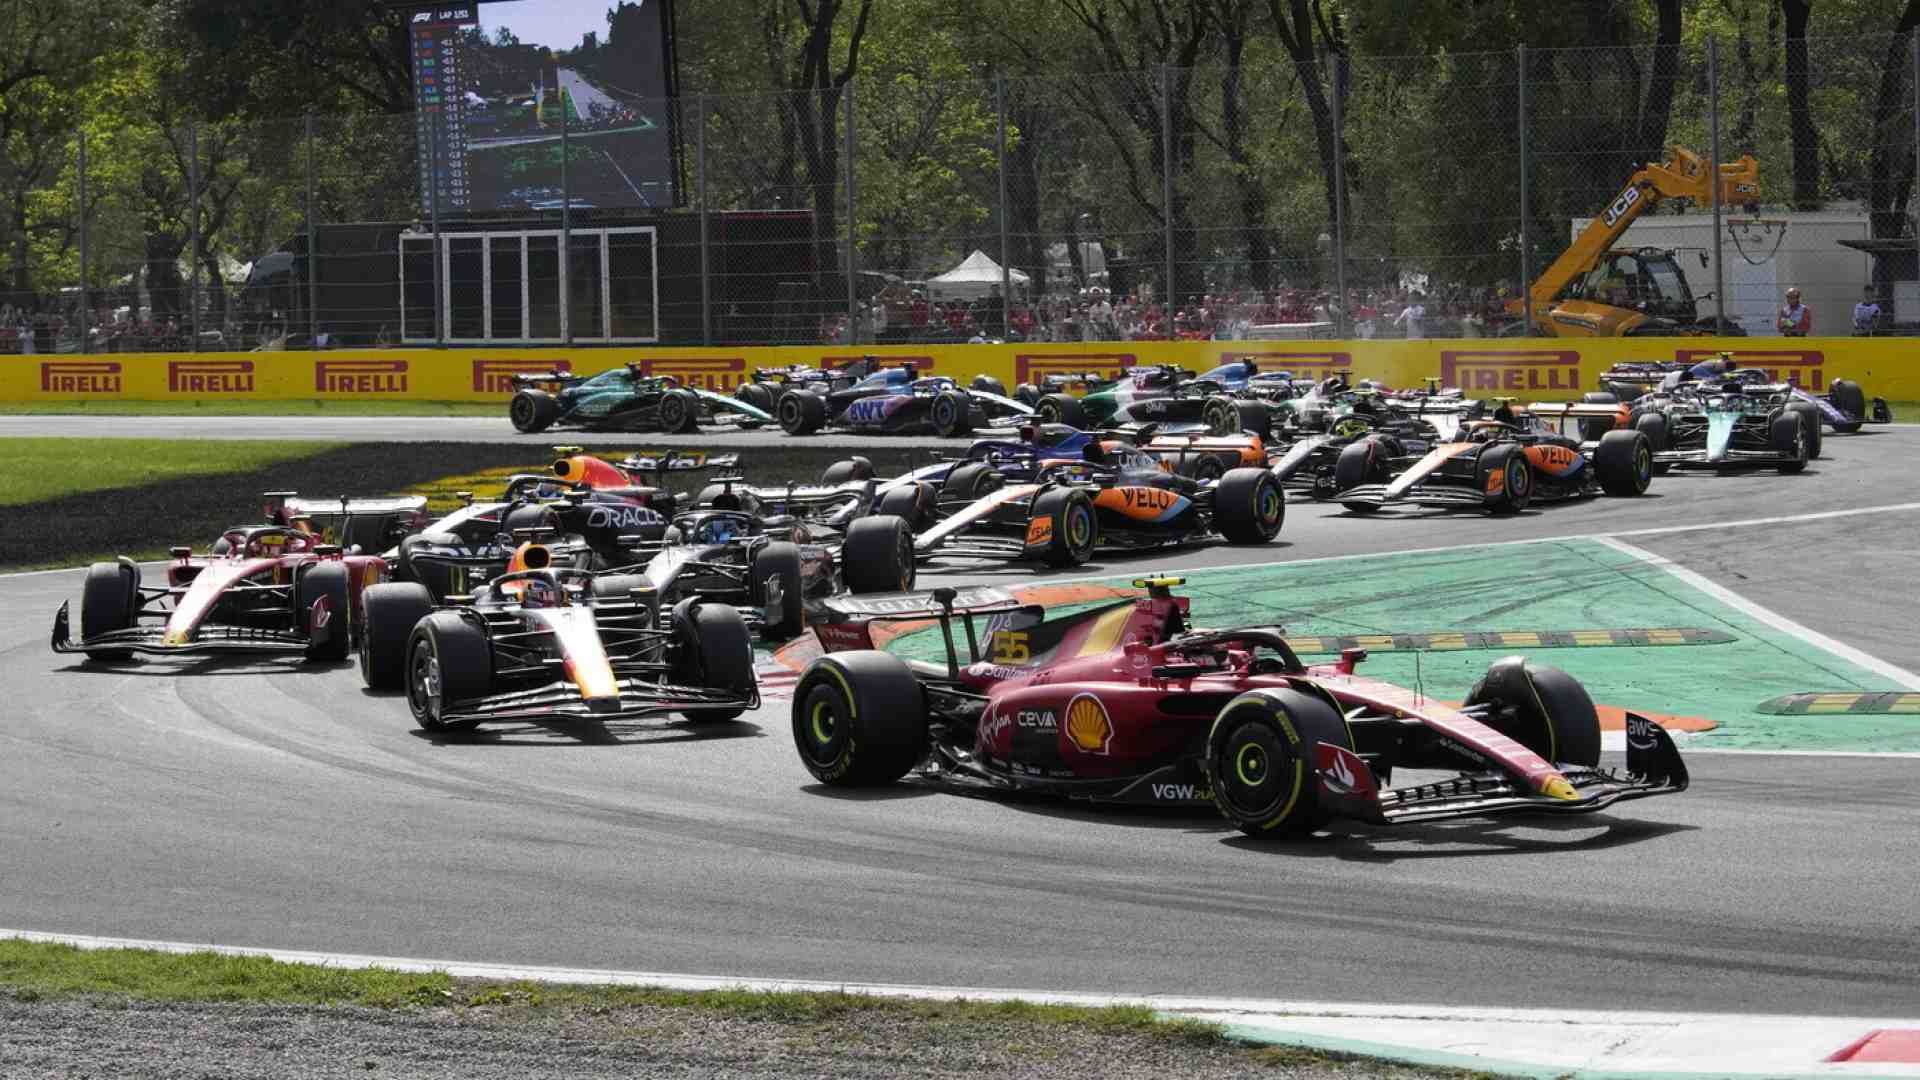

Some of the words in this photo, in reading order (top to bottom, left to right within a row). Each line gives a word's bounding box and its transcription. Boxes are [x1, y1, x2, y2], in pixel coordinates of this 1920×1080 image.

[1603, 186, 1641, 226] JCB
[41, 362, 122, 392] PIRELLI
[168, 361, 254, 392] PIRELLI
[315, 360, 408, 392] PIRELLI
[1440, 350, 1581, 391] PIRELLI
[848, 400, 886, 424] BWT
[1119, 487, 1169, 510] VELO
[587, 508, 666, 528] ORACLE
[992, 631, 1030, 665] 55
[1151, 783, 1194, 800] VGW
